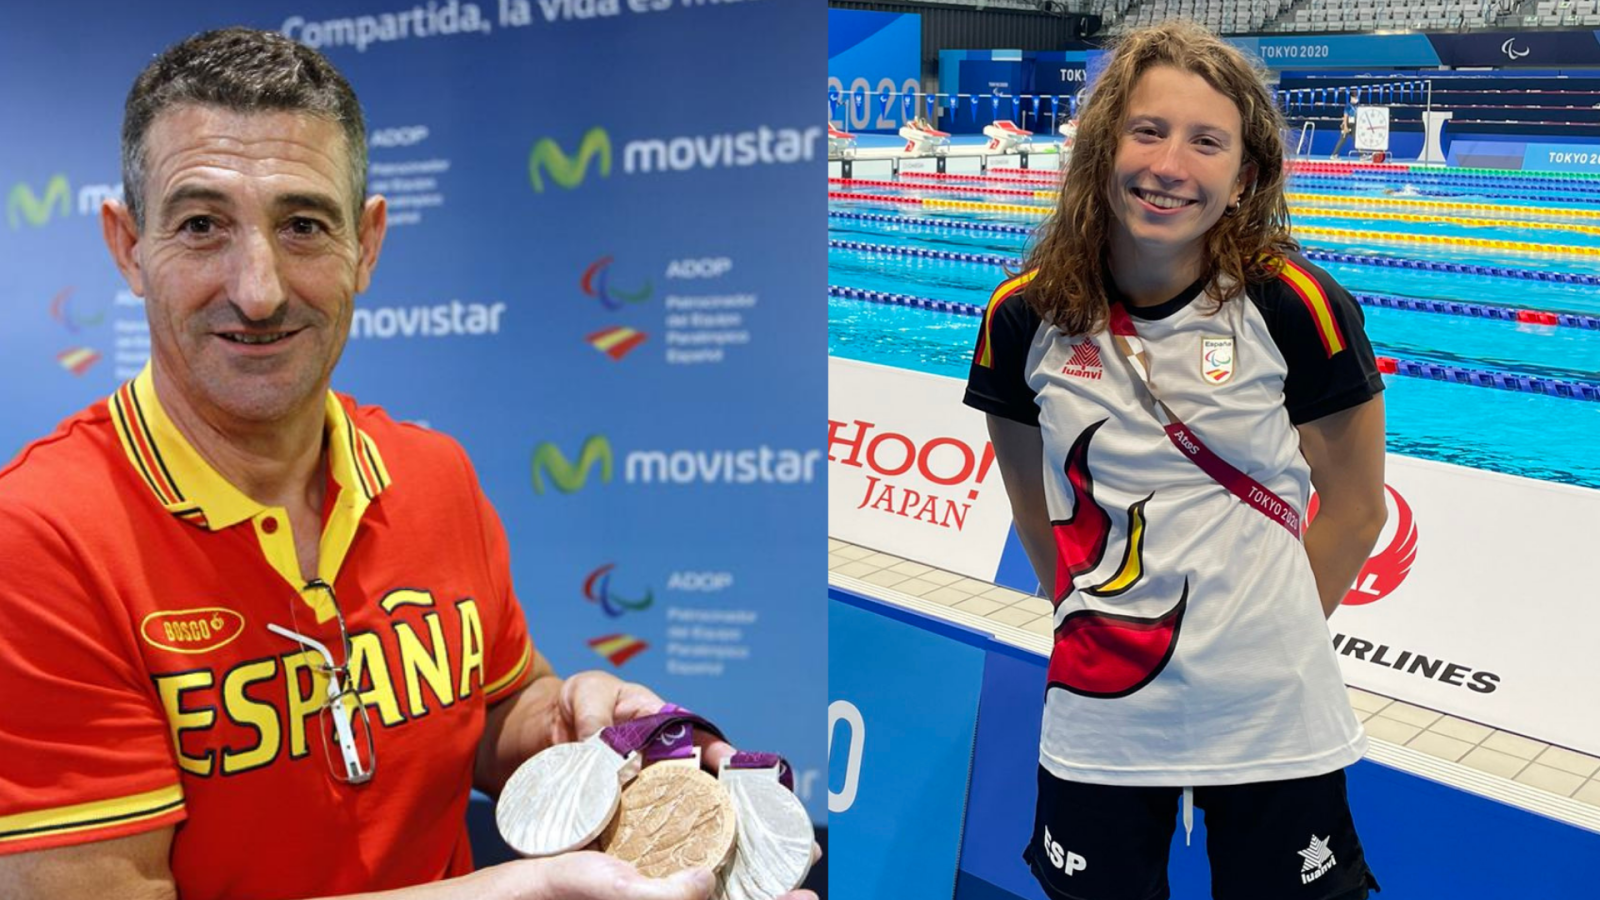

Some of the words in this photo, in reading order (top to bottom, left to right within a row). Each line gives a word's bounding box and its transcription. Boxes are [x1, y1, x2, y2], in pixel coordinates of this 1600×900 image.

[281, 0, 492, 52] Compartida,
[1260, 46, 1298, 58] TOKYO
[1300, 45, 1329, 58] 2020
[625, 126, 822, 174] movistar
[1549, 152, 1588, 164] TOKYO
[665, 257, 733, 278] ADOP
[1062, 366, 1103, 380] luanvi
[1174, 430, 1200, 455] Atos
[625, 446, 821, 484] movistar
[857, 475, 972, 531] JAPAN
[1248, 486, 1282, 515] TOKYO
[1281, 508, 1299, 530] 2020
[164, 618, 210, 642] BOSCO
[151, 588, 485, 777] ESPAÑA
[1044, 825, 1087, 876] ESP
